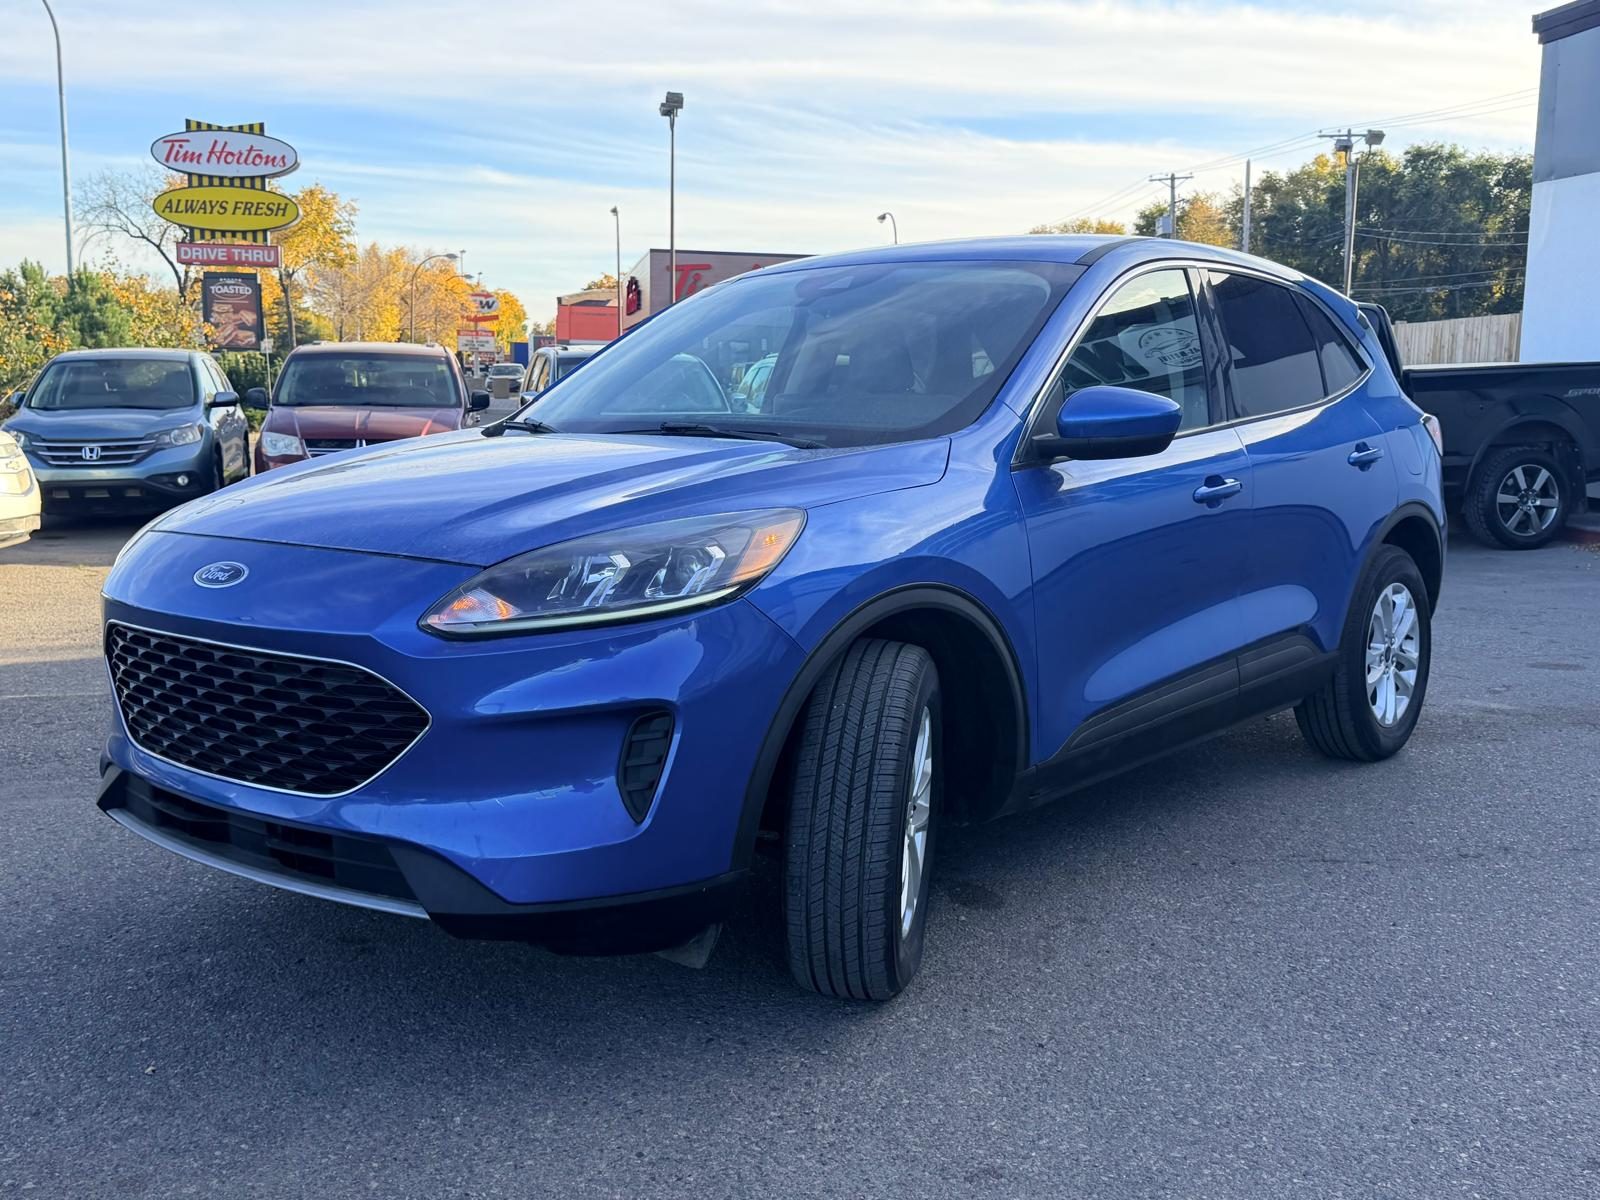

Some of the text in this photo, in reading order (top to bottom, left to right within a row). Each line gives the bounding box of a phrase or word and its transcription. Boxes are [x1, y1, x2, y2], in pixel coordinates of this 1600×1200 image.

[162, 139, 287, 168] Tim Hortons
[162, 199, 289, 217] ALWAYS FRESH
[180, 247, 275, 262] DRIVE THRU
[210, 285, 252, 295] TOASTED
[202, 564, 235, 581] Ford
